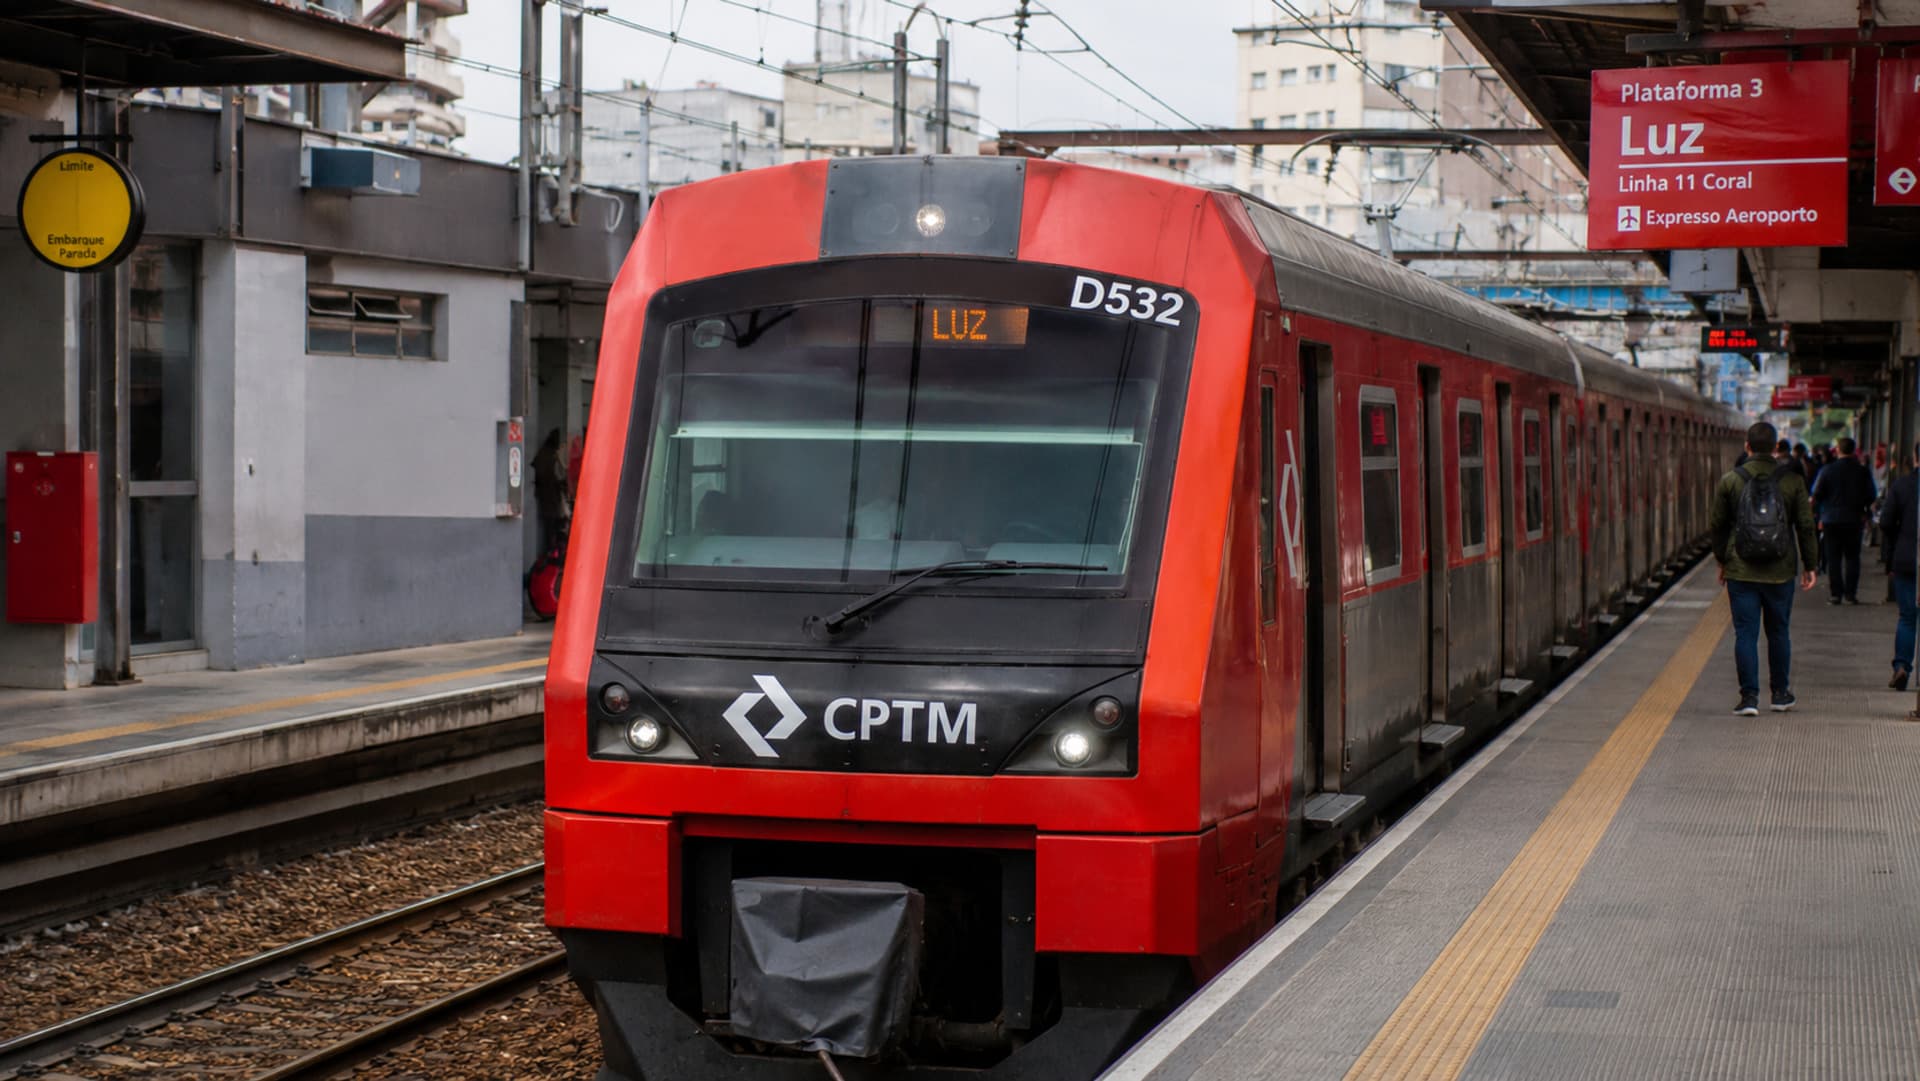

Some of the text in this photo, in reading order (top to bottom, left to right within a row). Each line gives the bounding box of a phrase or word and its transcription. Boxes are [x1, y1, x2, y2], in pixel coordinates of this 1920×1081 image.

[1621, 78, 1764, 103] Plataforma 3
[1620, 115, 1705, 157] Luz
[59, 160, 95, 172] Limite
[1619, 171, 1753, 193] Linha 11 Coral
[1646, 207, 1818, 229] Expresso Aeroporto
[59, 248, 97, 259] Parada
[1070, 275, 1184, 327] D532
[932, 307, 988, 341] LUZ
[823, 697, 978, 745] CPTM
